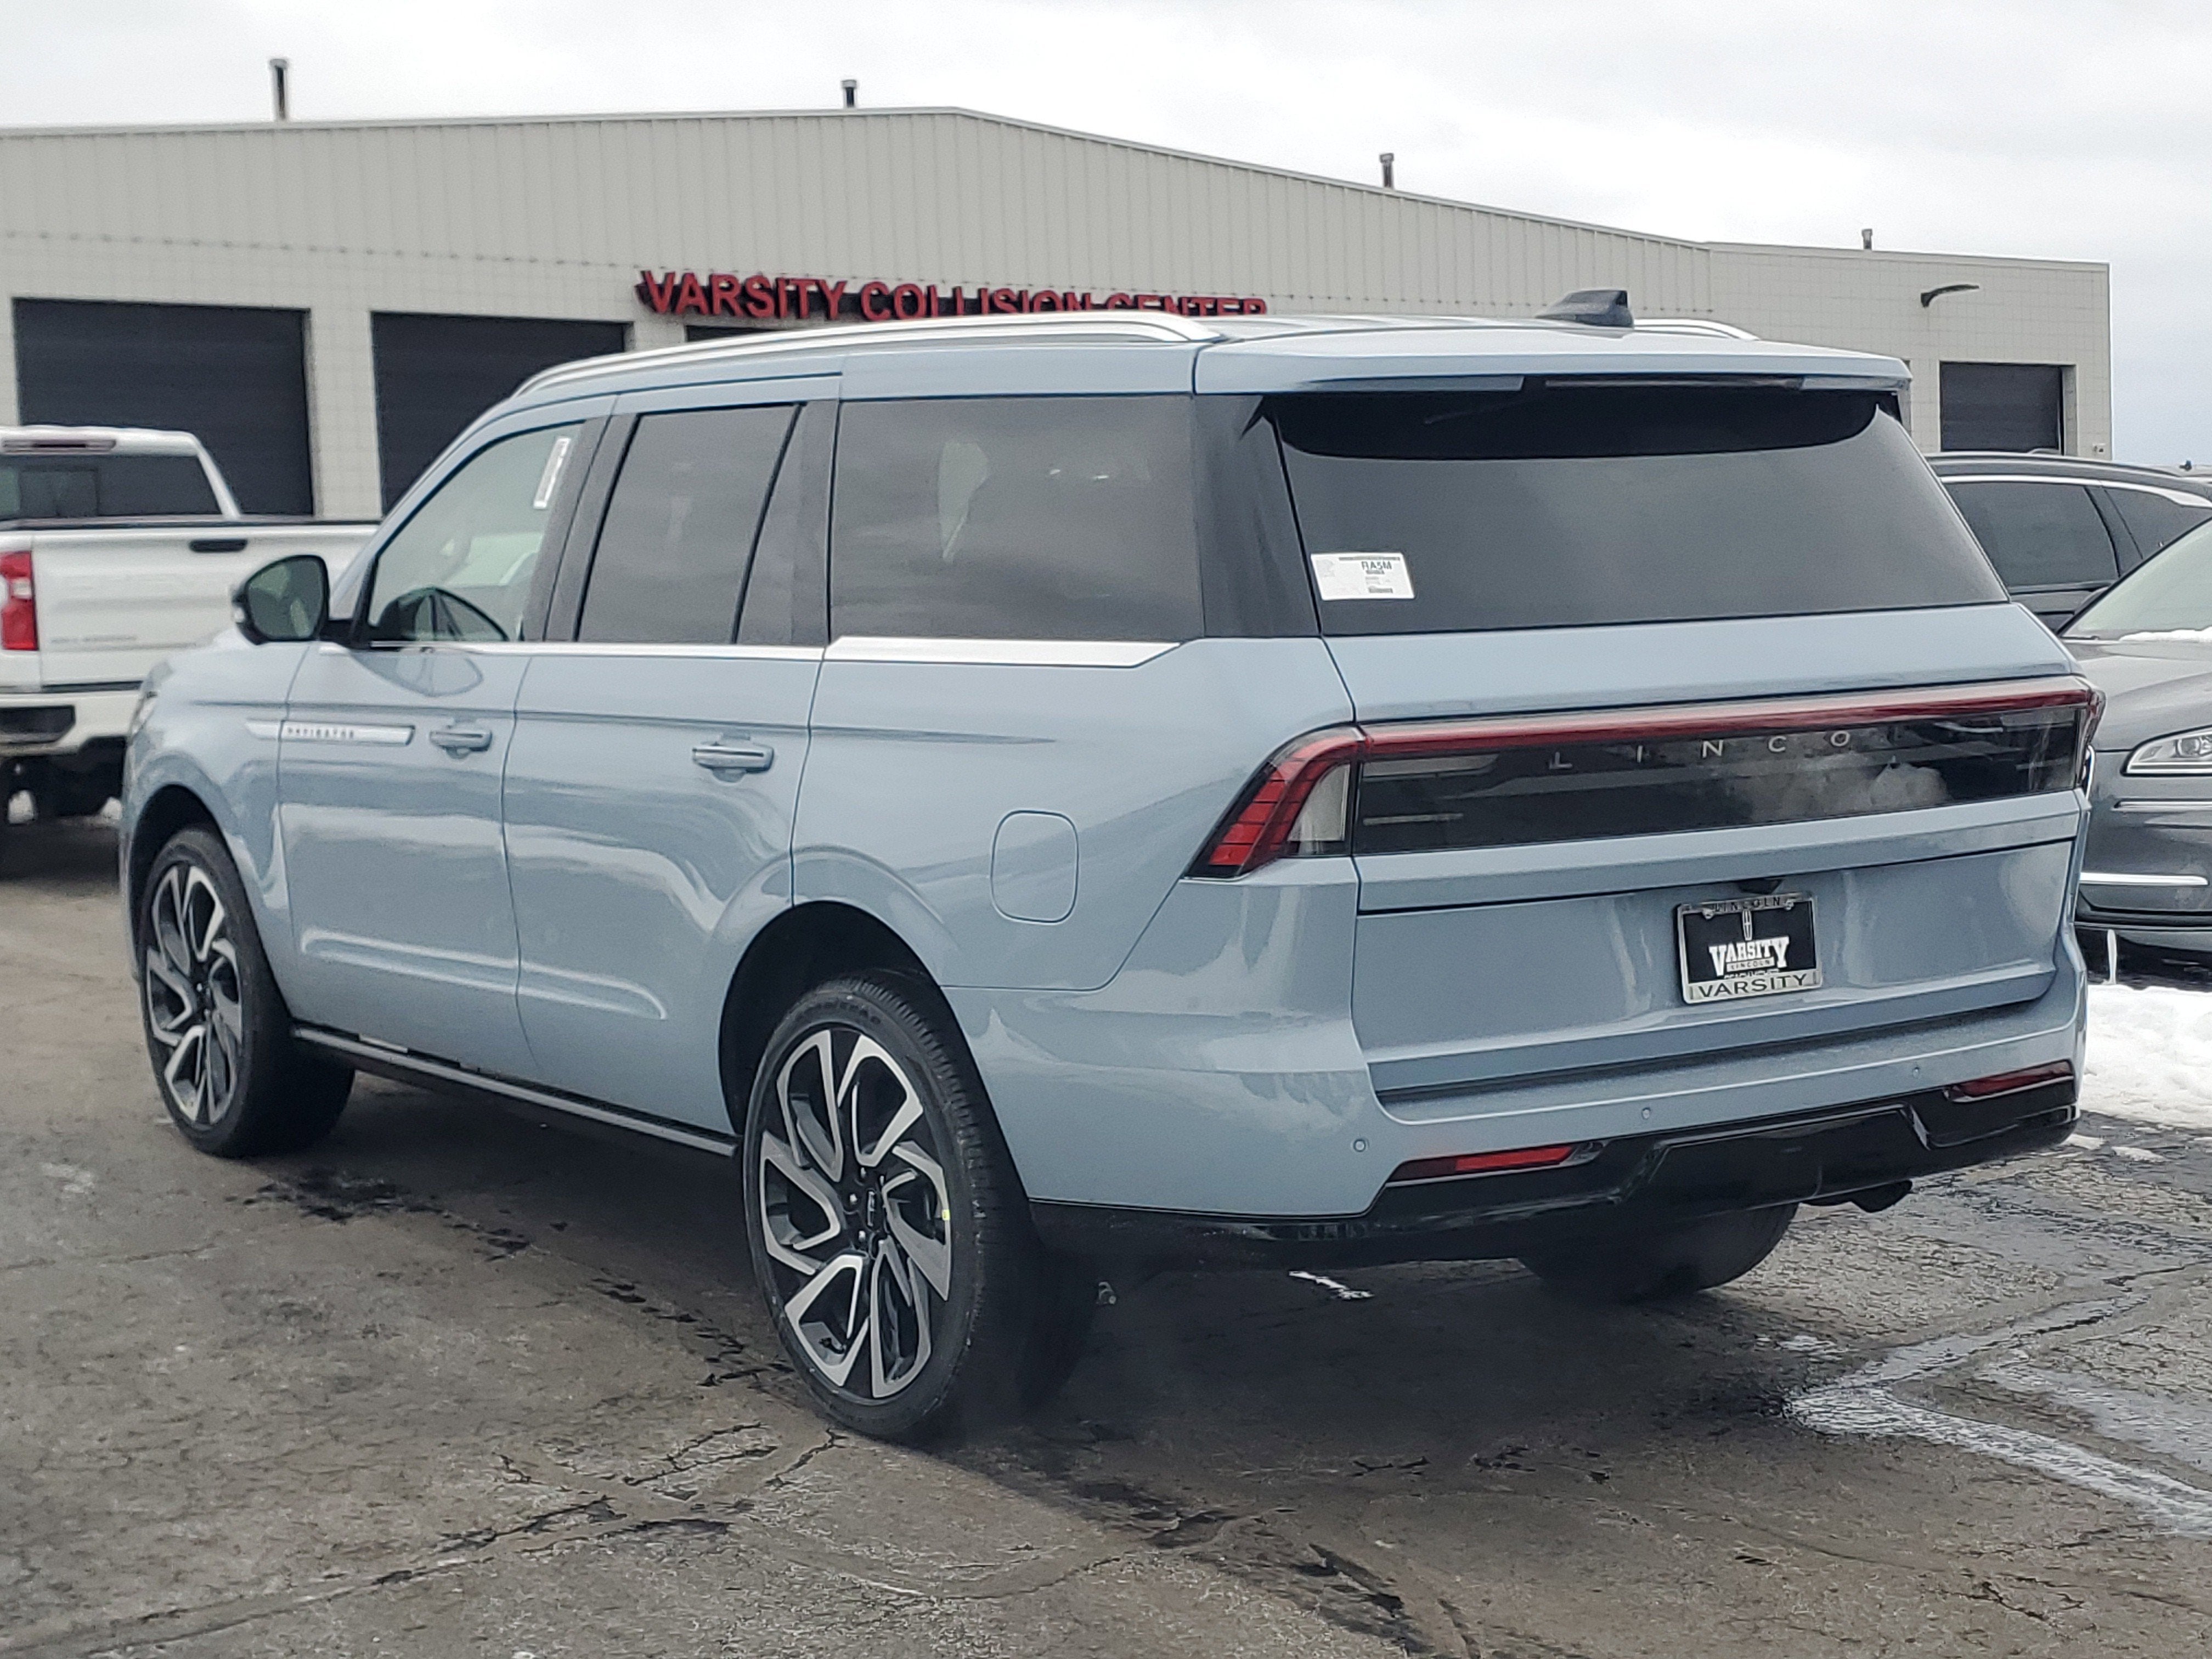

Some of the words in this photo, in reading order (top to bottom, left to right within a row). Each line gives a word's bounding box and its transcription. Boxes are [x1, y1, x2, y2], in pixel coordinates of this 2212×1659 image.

[635, 270, 847, 320] VARSITY
[860, 281, 1091, 320] COLLISION
[1714, 896, 1781, 912] LINCOLN
[1708, 936, 1790, 977] VARSITY
[1730, 960, 1771, 970] LINCOLN
[1699, 973, 1807, 998] VARSITY
